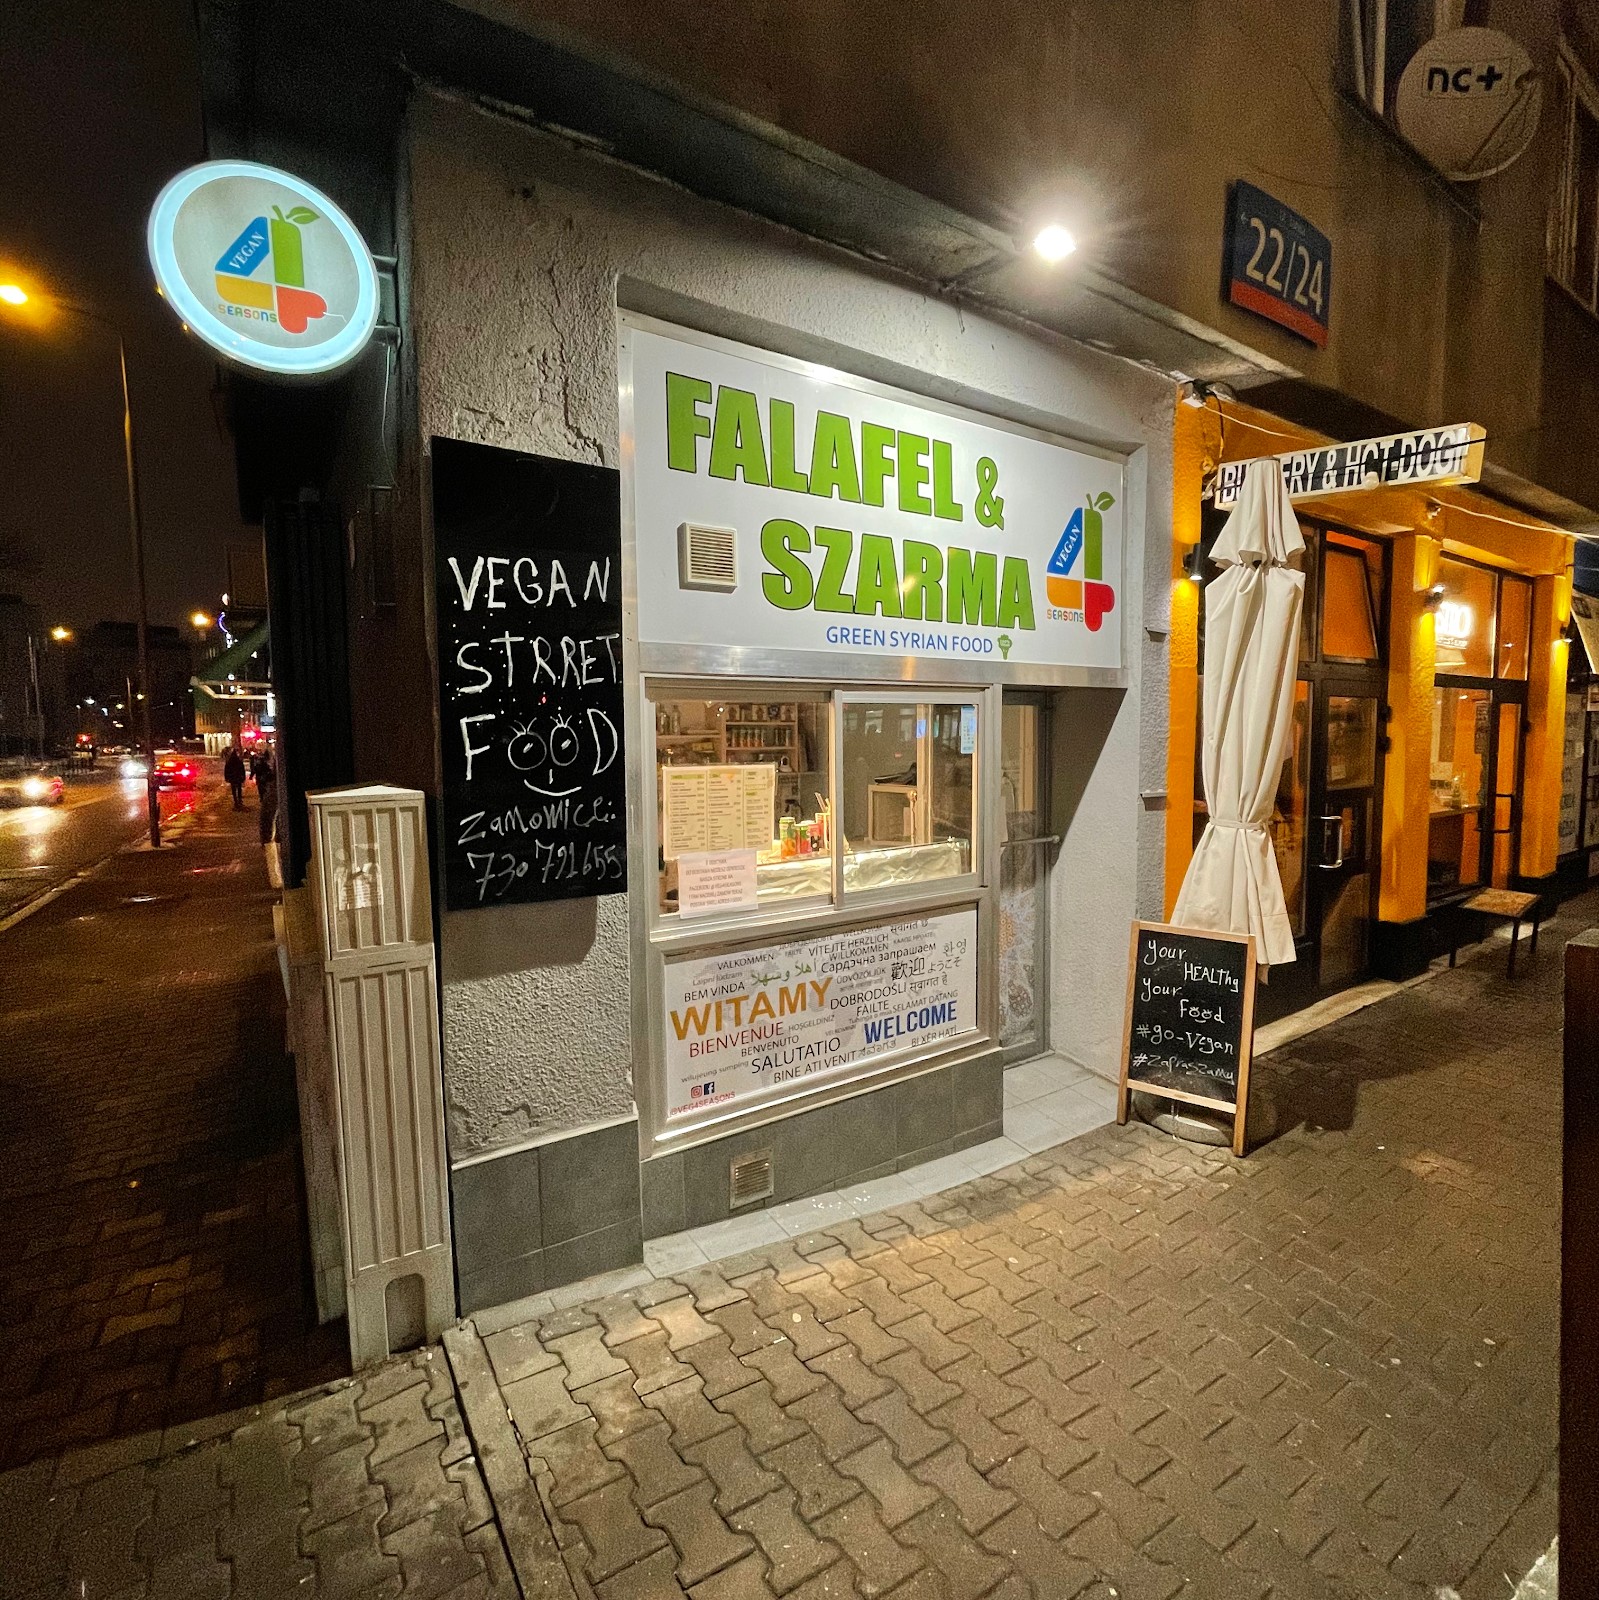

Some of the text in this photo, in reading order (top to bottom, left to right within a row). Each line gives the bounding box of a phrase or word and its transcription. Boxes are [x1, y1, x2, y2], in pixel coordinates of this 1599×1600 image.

[1427, 65, 1503, 93] nc+
[229, 231, 266, 269] VEGAN
[1245, 217, 1325, 316] 22/24
[665, 371, 1006, 531] FALAFEL &
[1221, 450, 1321, 503] BERY
[1322, 449, 1338, 490] &
[1055, 524, 1082, 569] VEGAN
[447, 556, 611, 611] VEGAN
[760, 518, 1037, 632] SZARMA
[826, 626, 885, 647] GREEN
[889, 630, 948, 651] SYRIAN
[952, 636, 993, 654] FOOD
[459, 708, 618, 781] FOOD
[467, 851, 529, 900] 730
[821, 943, 937, 974] Сардэчна запрашаем
[829, 942, 889, 961] WILLKOMMEN
[847, 933, 889, 948] HERZLICH
[927, 956, 962, 974] ようこそ
[669, 975, 833, 1042] WITAMY
[684, 981, 745, 1002] BEM VINDA
[892, 989, 958, 1013] SELAMAT DATANG
[689, 1021, 784, 1058] BIENVENUE
[864, 1000, 957, 1044] WELCOME
[741, 1035, 799, 1057] BENVENUTO
[751, 1037, 840, 1074] SALUTATIO
[773, 1050, 856, 1084] BINE ATI VENIT
